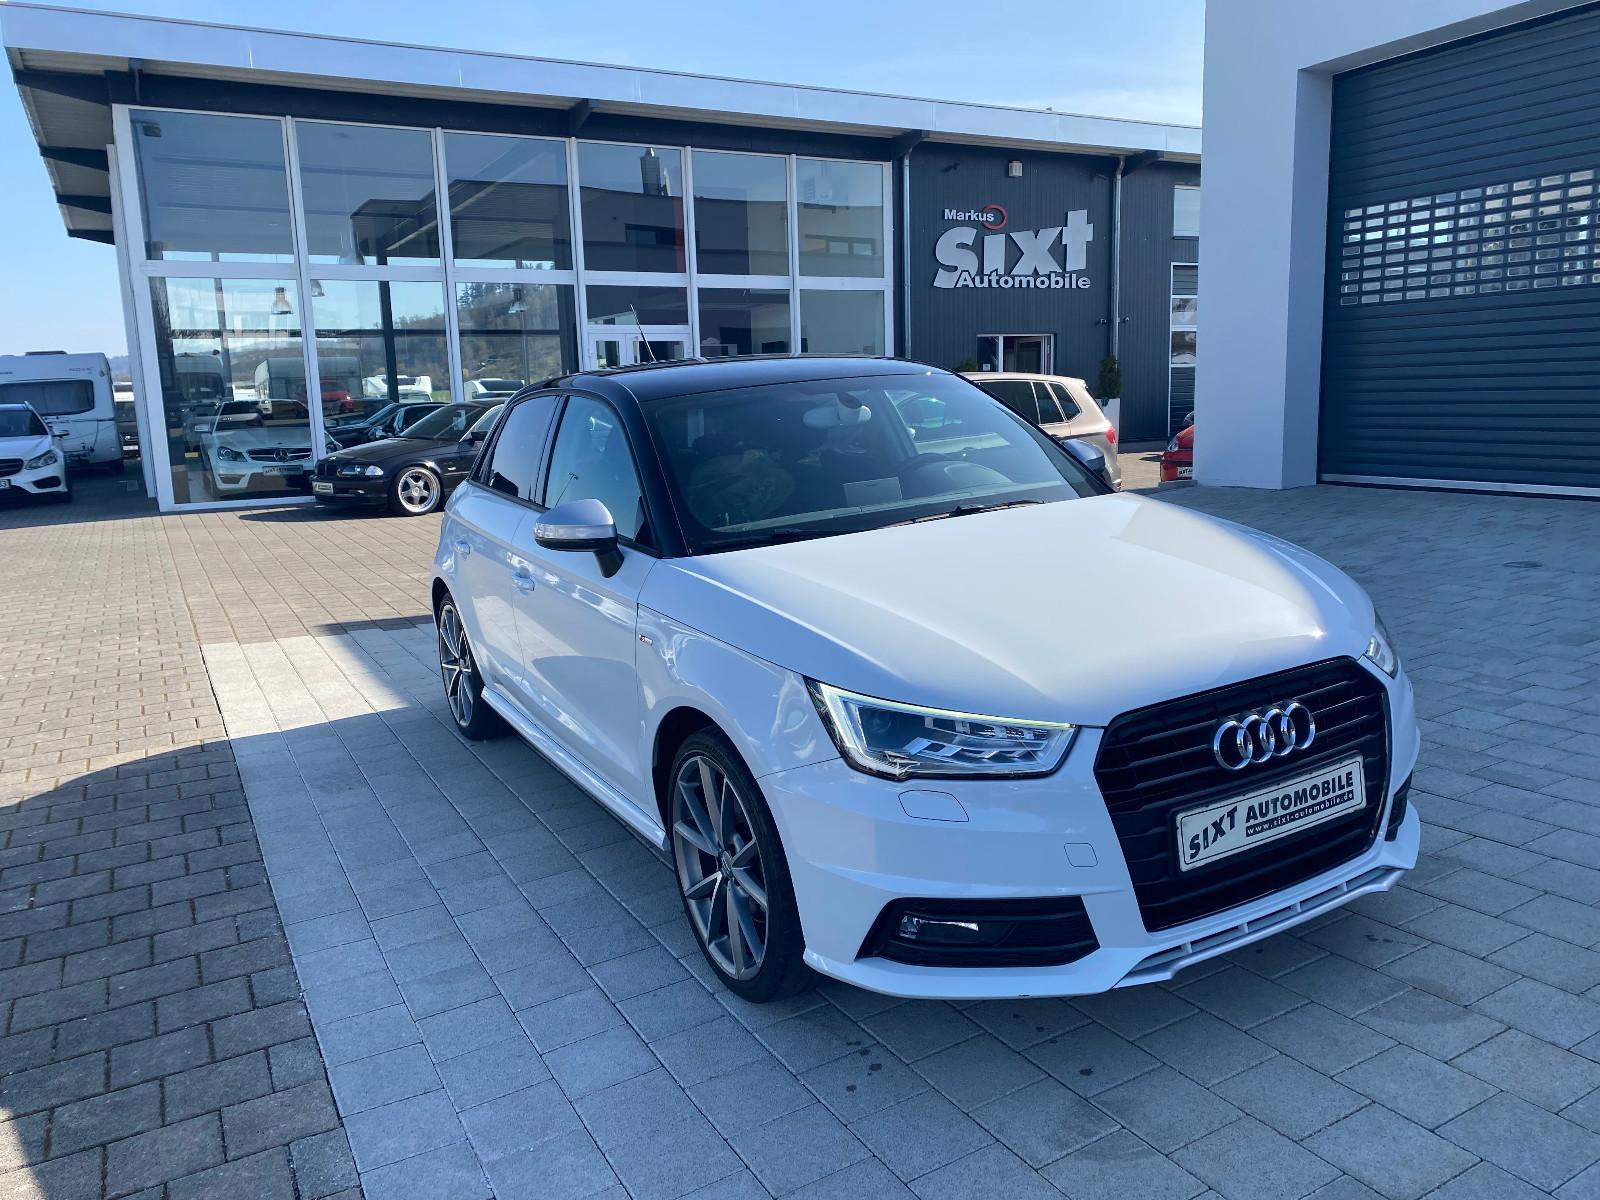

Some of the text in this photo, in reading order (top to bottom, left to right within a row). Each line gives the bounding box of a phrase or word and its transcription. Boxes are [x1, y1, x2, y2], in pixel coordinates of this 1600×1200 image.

[944, 208, 995, 222] Markus
[956, 270, 1091, 289] Automobile
[1189, 770, 1354, 860] SIXT AUTOMOBILE
